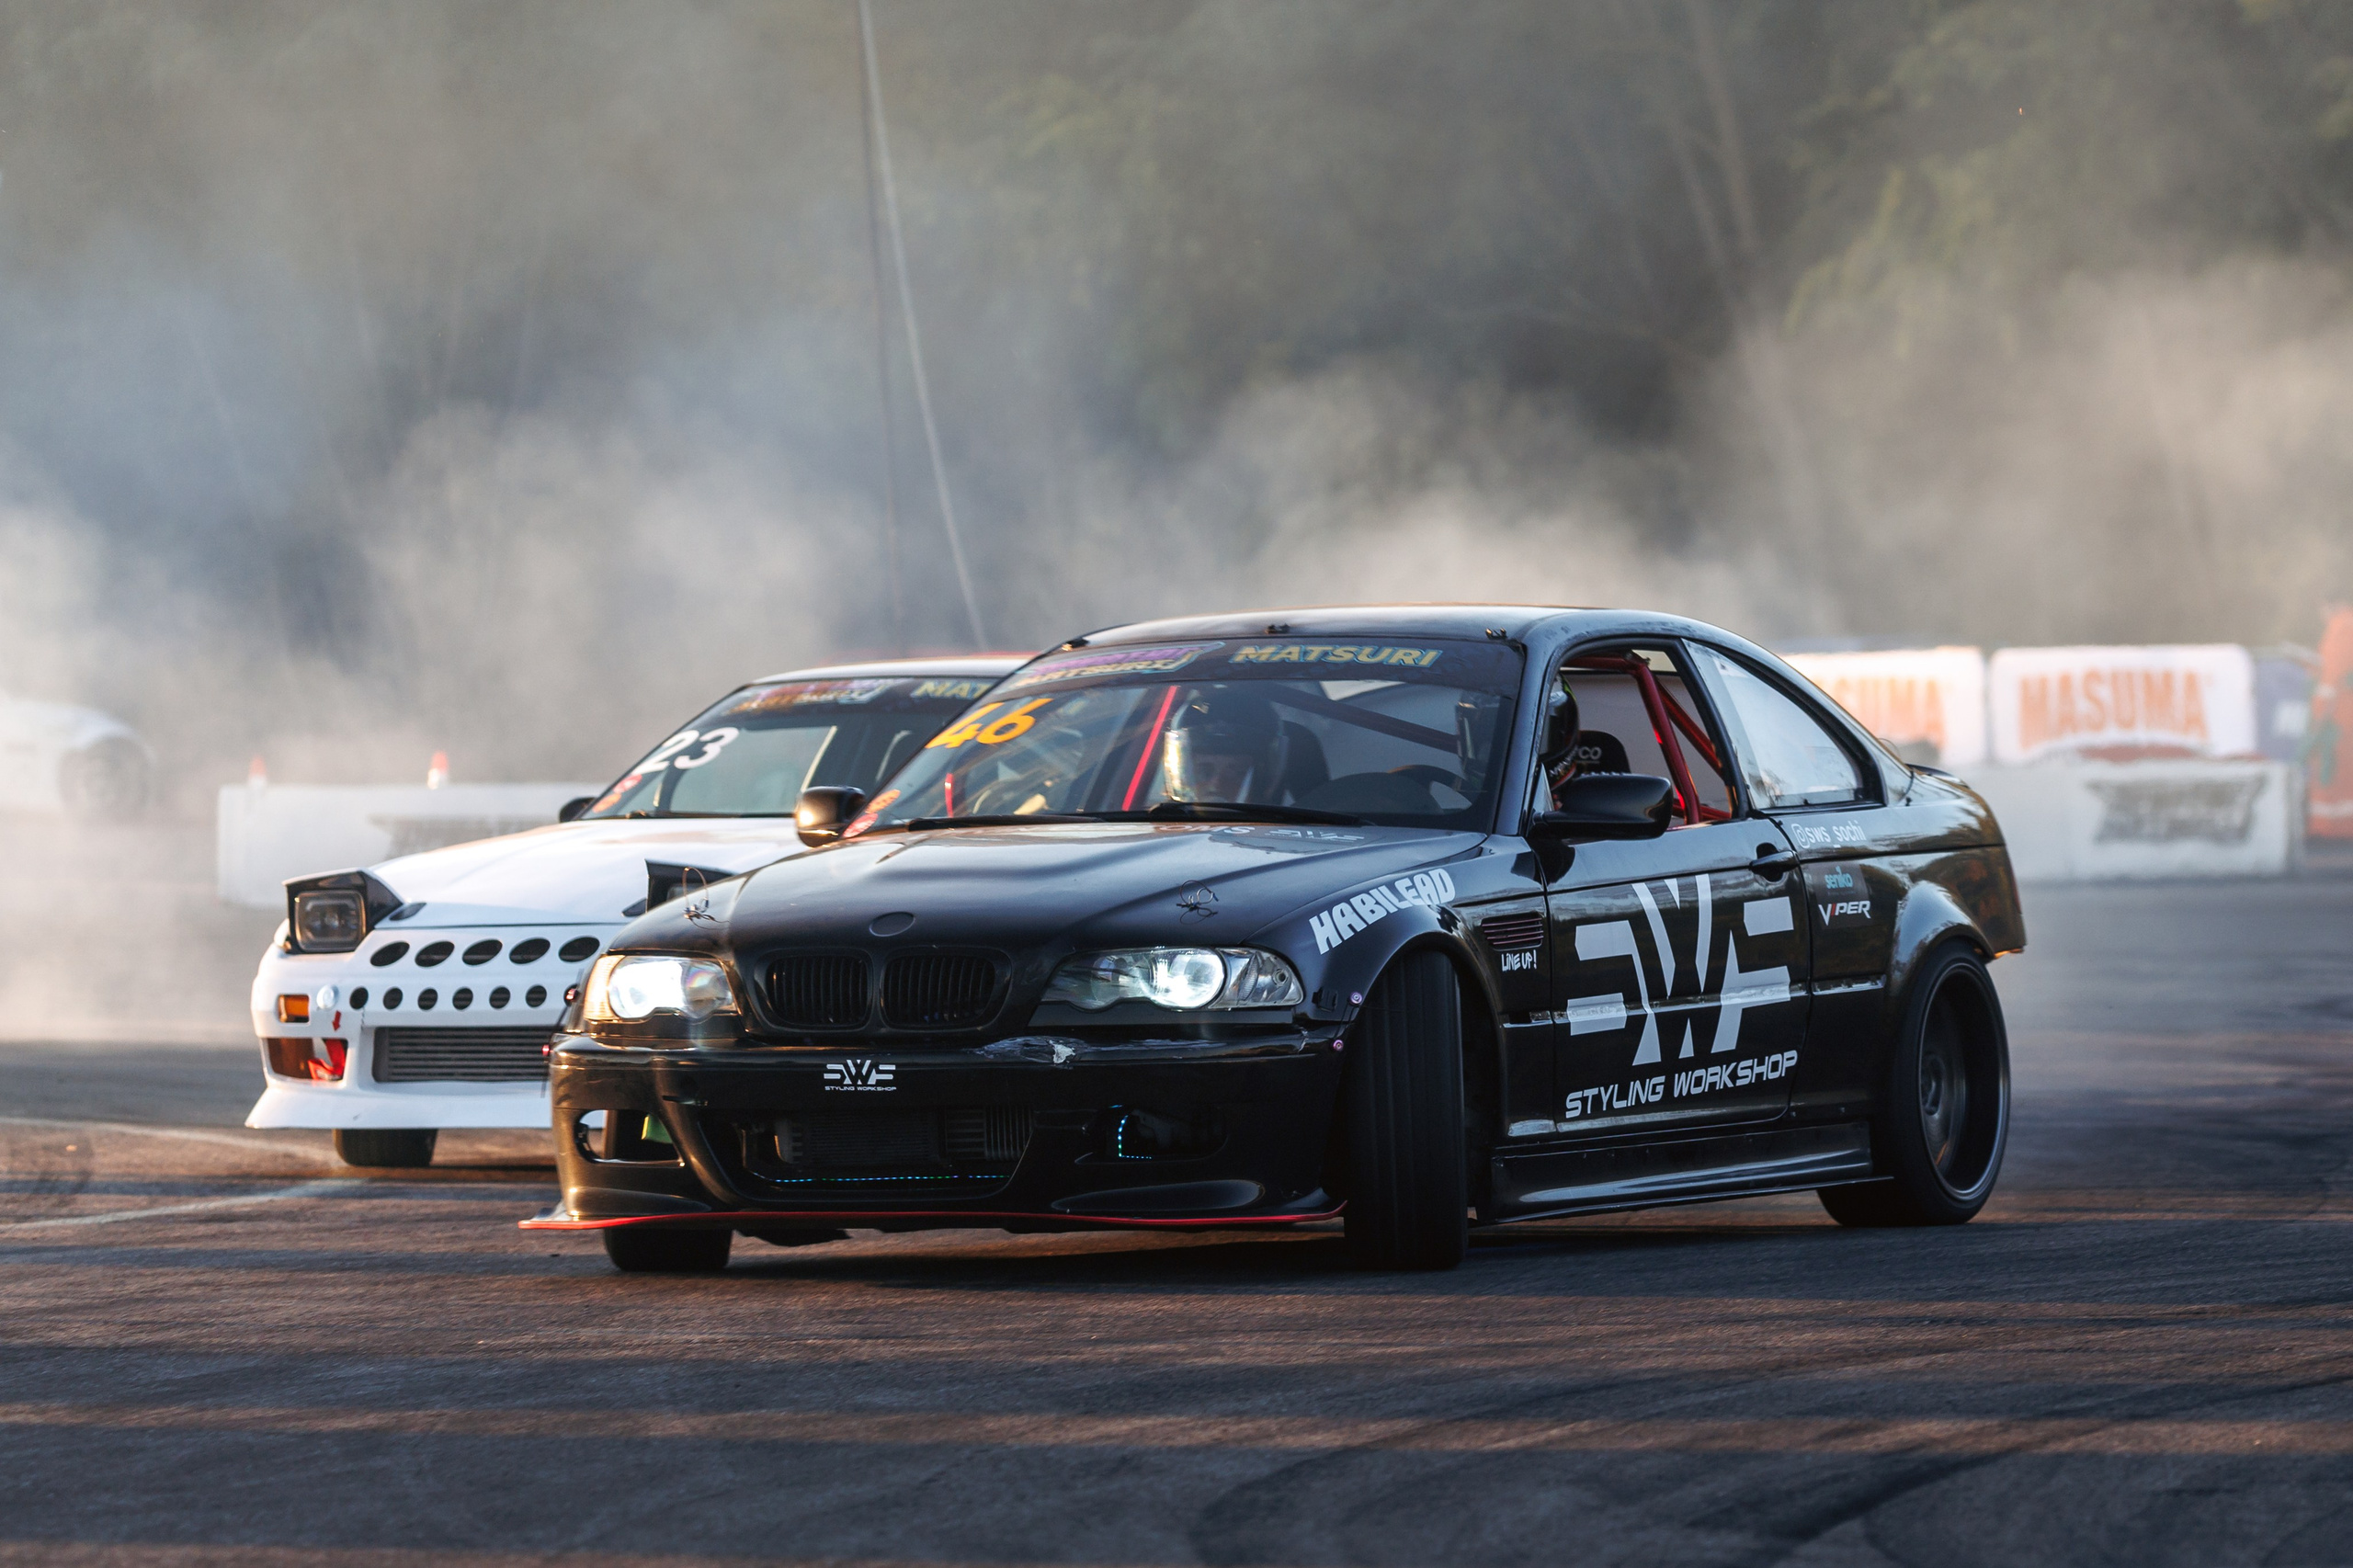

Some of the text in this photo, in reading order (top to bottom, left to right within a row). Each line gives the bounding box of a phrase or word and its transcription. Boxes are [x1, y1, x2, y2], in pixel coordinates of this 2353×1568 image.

[1229, 645, 1443, 668] MATSURI
[925, 698, 1054, 749] 46
[2018, 667, 2209, 752] MASUMA
[631, 726, 739, 775] 23
[1309, 869, 1456, 955] HABILEAD
[1818, 900, 1871, 926] VIPER
[1565, 1050, 1798, 1119] STYLING WORKSHOP
